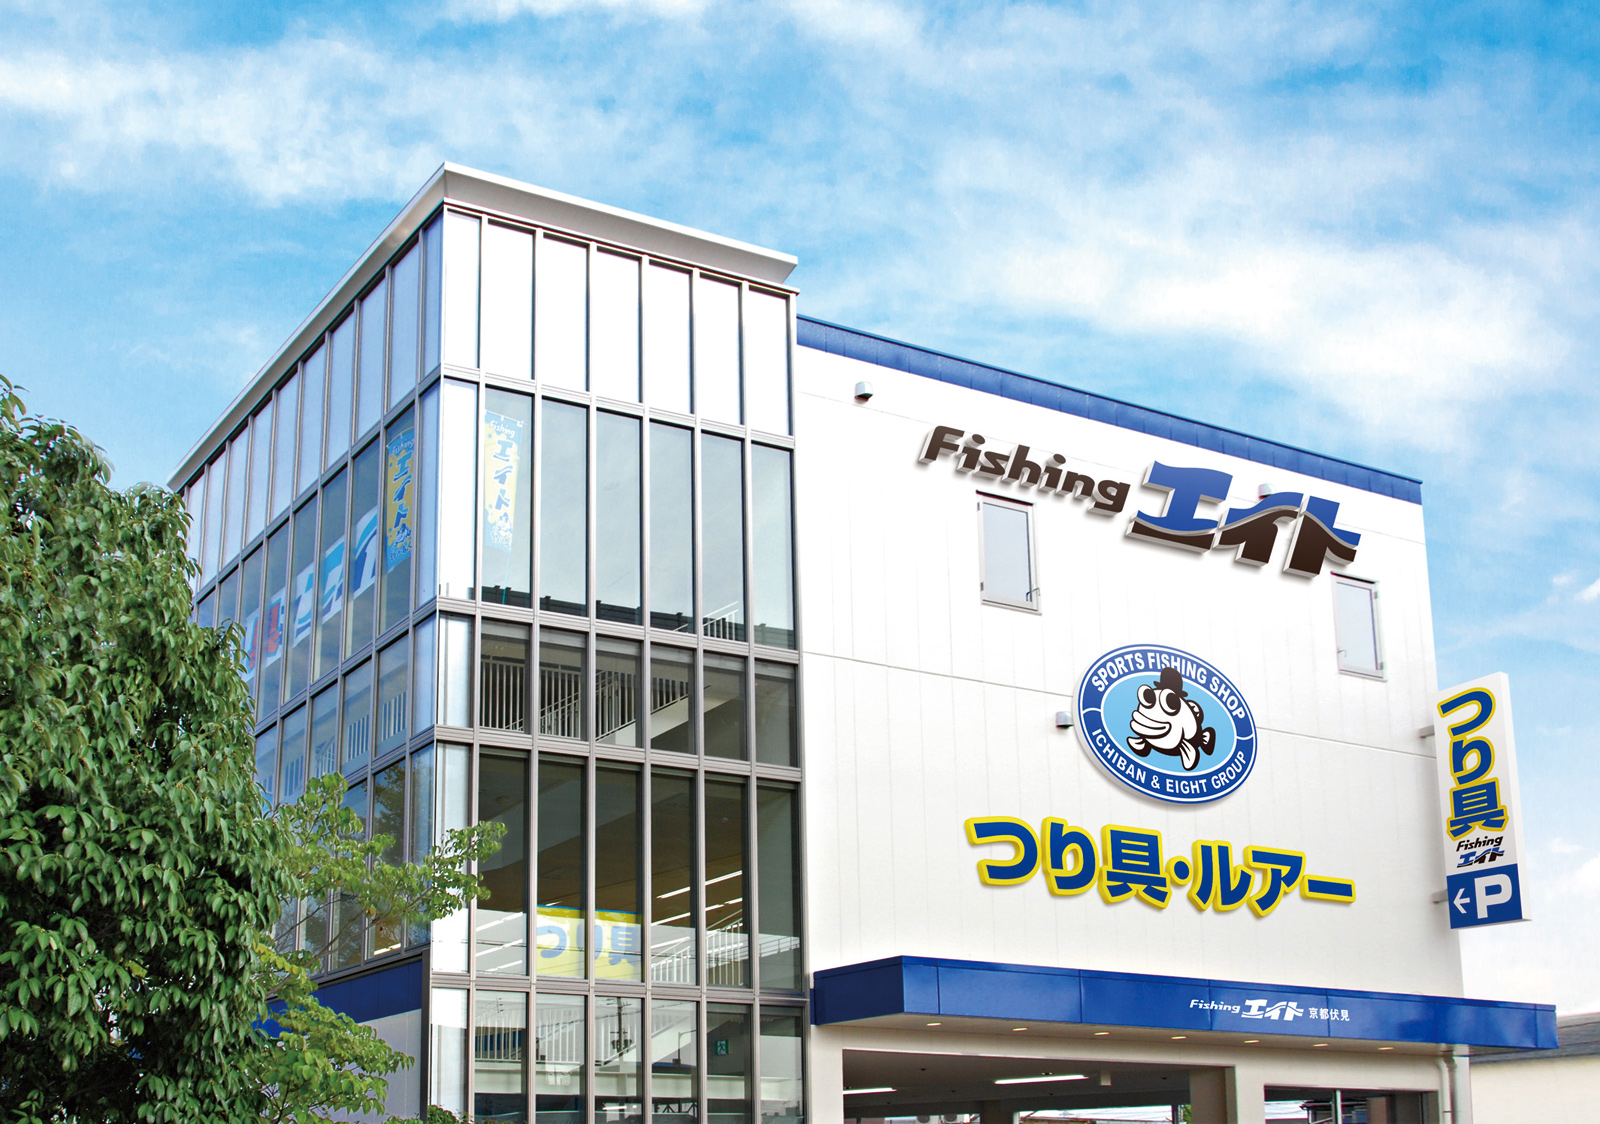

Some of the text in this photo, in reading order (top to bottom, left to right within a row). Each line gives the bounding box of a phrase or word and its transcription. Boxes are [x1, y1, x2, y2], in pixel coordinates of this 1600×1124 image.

[490, 420, 515, 438] Fishing
[392, 450, 413, 530] エイト
[493, 439, 514, 511] エイト
[920, 425, 1361, 578] Fishing エイト
[1091, 652, 1246, 720] SPORTS FISHING SHOP
[1092, 728, 1247, 794] ICHIBAN & EIGHT GROUP
[1438, 687, 1509, 841] つり具
[1456, 836, 1504, 852] Fishing
[1456, 846, 1505, 868] エイト
[1474, 873, 1513, 919] P
[537, 923, 641, 967] つり具
[1189, 998, 1350, 1022] Fishing エイト 京都伏見
